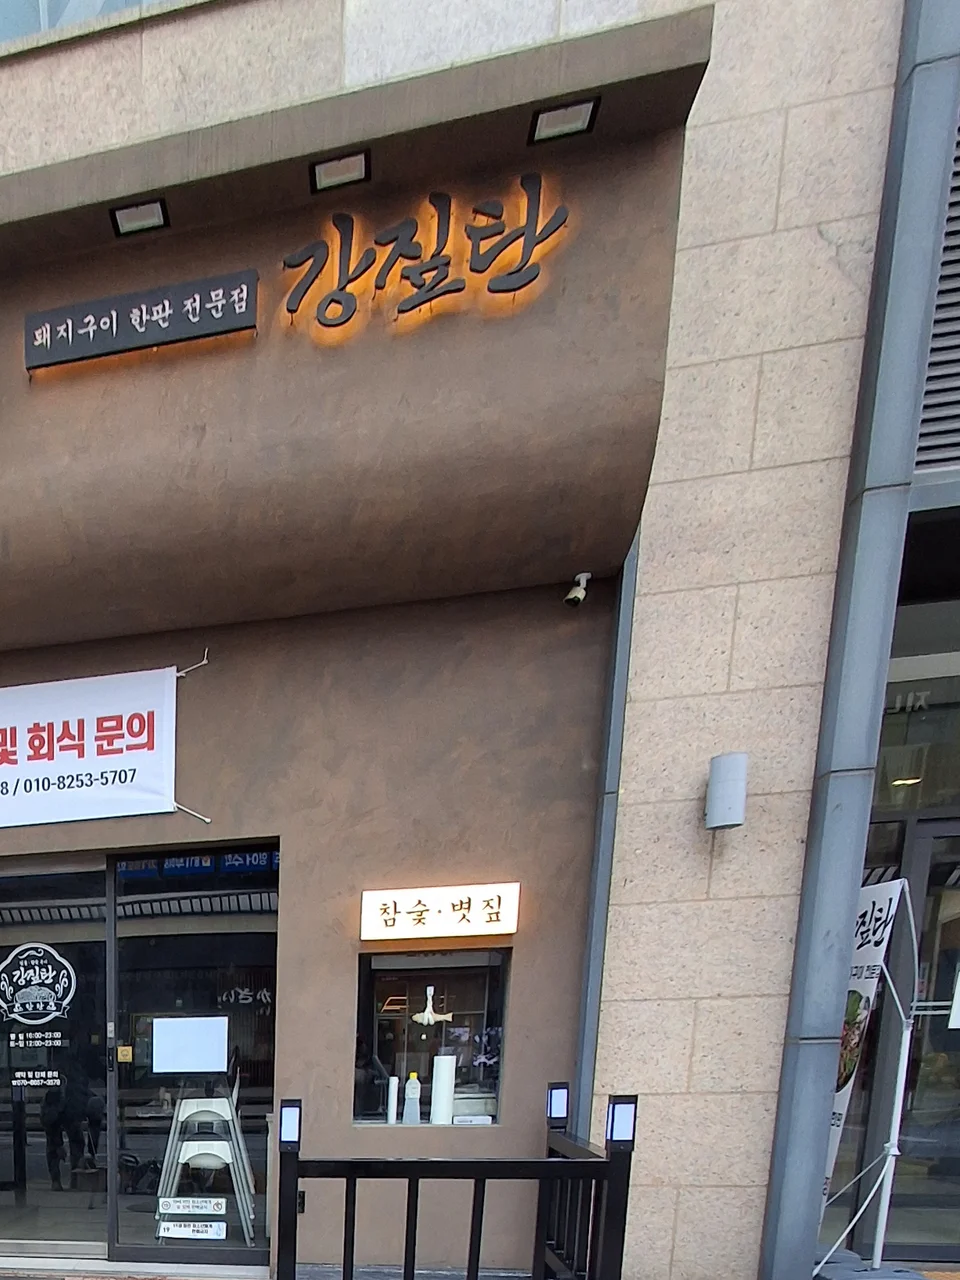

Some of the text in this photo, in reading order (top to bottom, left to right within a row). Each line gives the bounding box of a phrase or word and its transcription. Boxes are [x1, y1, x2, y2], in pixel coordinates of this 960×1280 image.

[32, 284, 248, 349] 돼지구이 한판 전문점
[26, 718, 86, 762] 회식
[94, 710, 156, 756] 문의
[23, 768, 138, 793] 010-8253-5707
